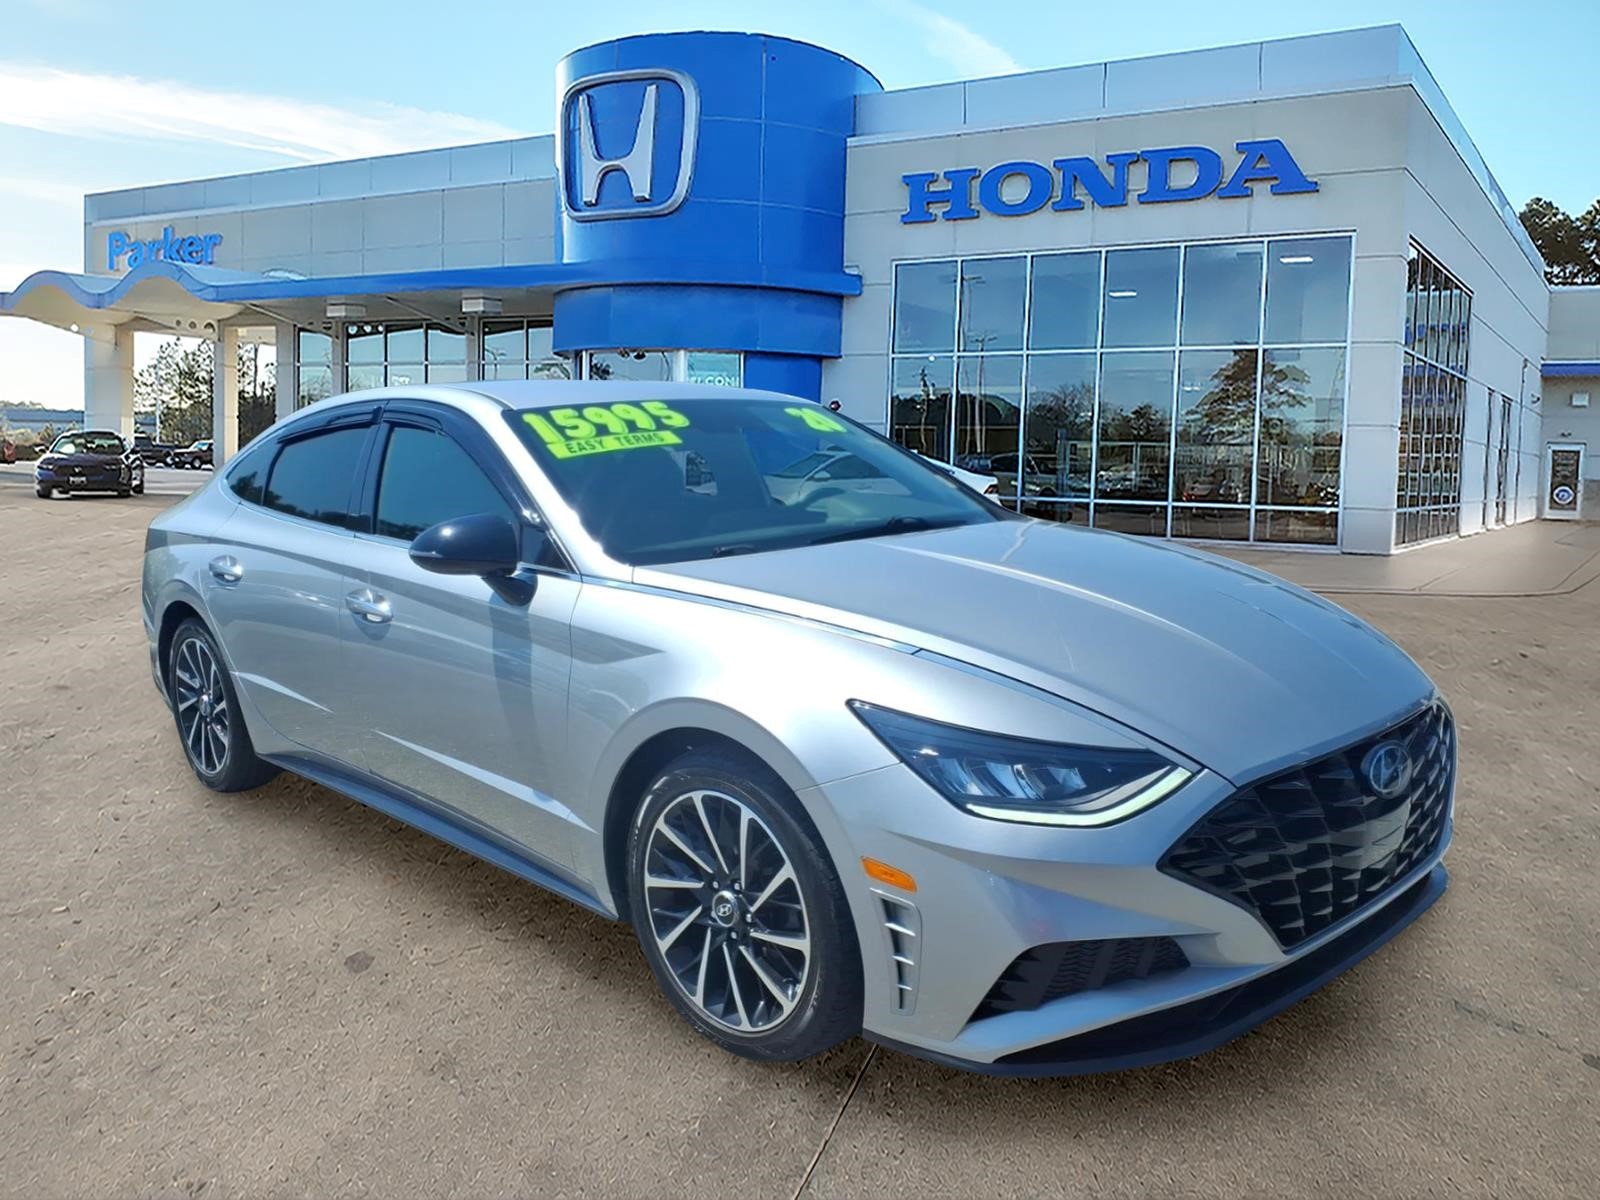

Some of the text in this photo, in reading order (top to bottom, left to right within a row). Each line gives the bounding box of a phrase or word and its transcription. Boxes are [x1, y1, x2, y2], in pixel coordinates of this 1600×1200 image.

[900, 138, 1320, 224] HONDA
[107, 225, 223, 271] Parker
[522, 401, 690, 444] 15995
[567, 432, 665, 454] EASY TERMS
